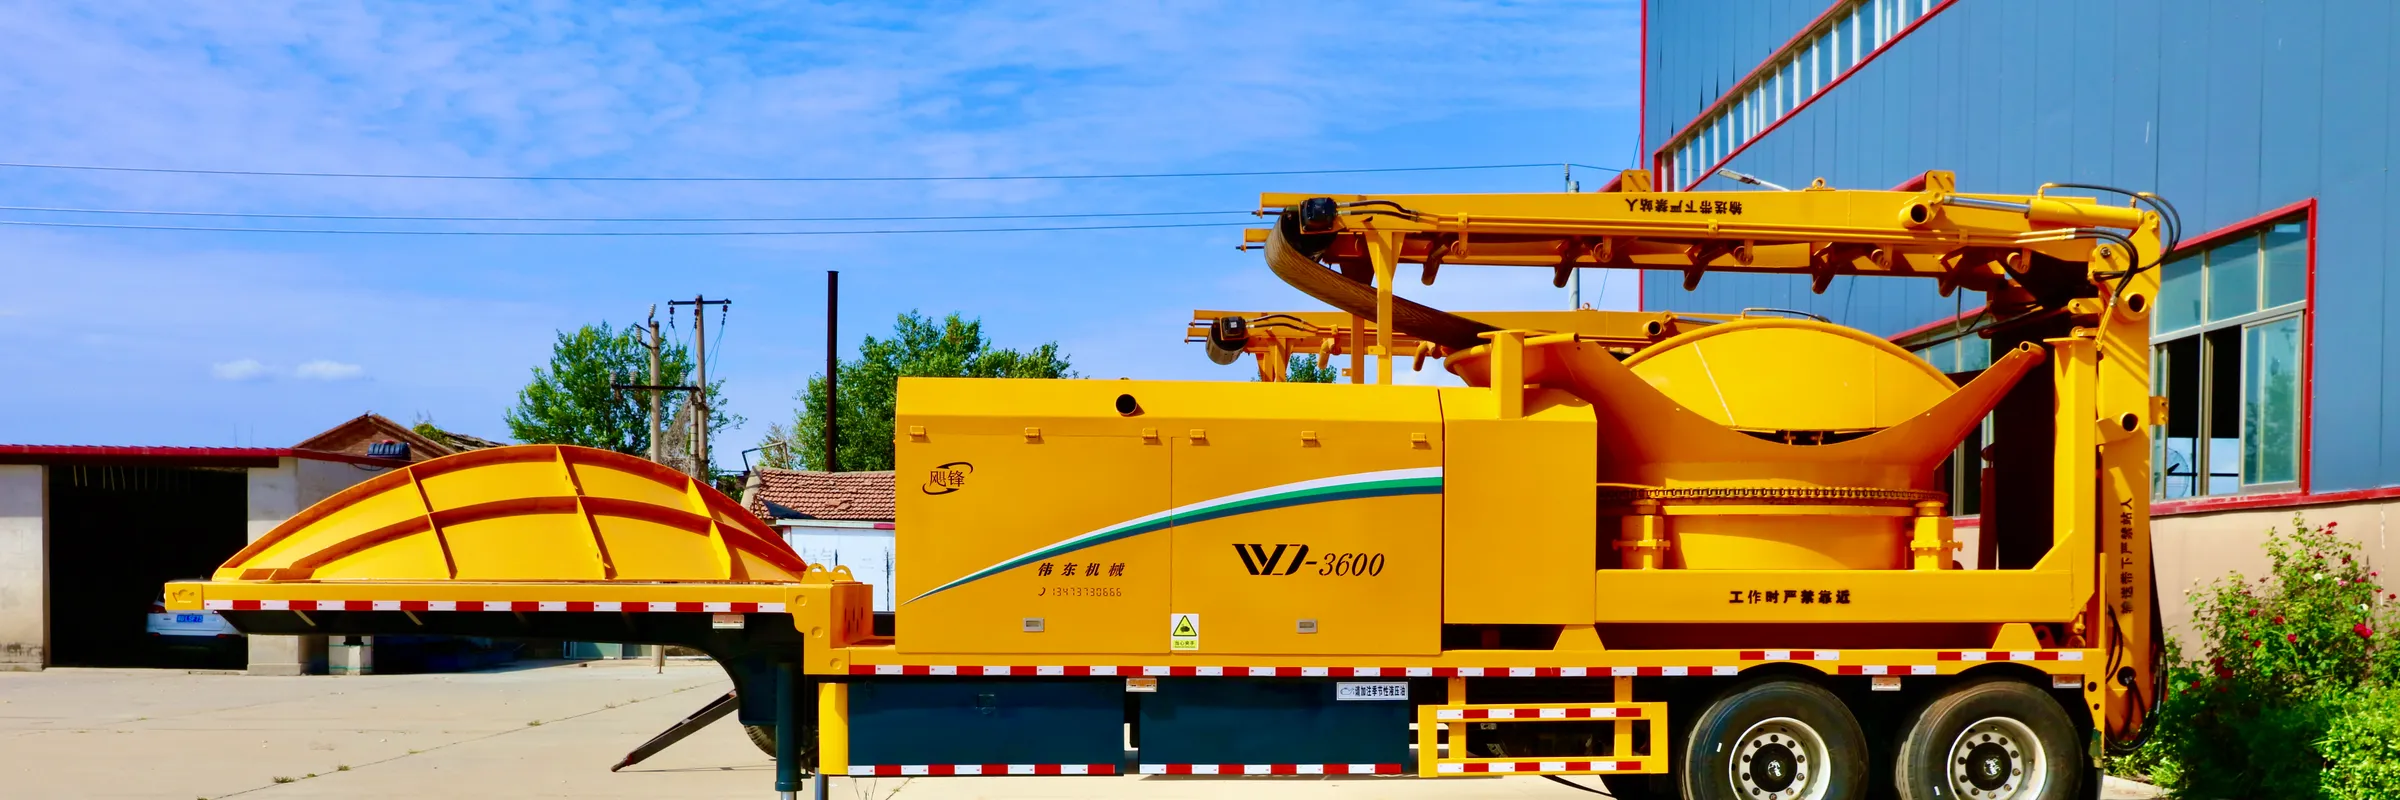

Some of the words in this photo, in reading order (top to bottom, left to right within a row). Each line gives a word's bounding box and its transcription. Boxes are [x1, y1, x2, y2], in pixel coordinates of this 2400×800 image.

[1625, 198, 1742, 215] 输送带下严禁站人
[2120, 498, 2133, 614] 输送带下严禁站人
[1038, 562, 1125, 577] 伟东机械
[1729, 589, 1850, 604] 工作时严禁靠近
